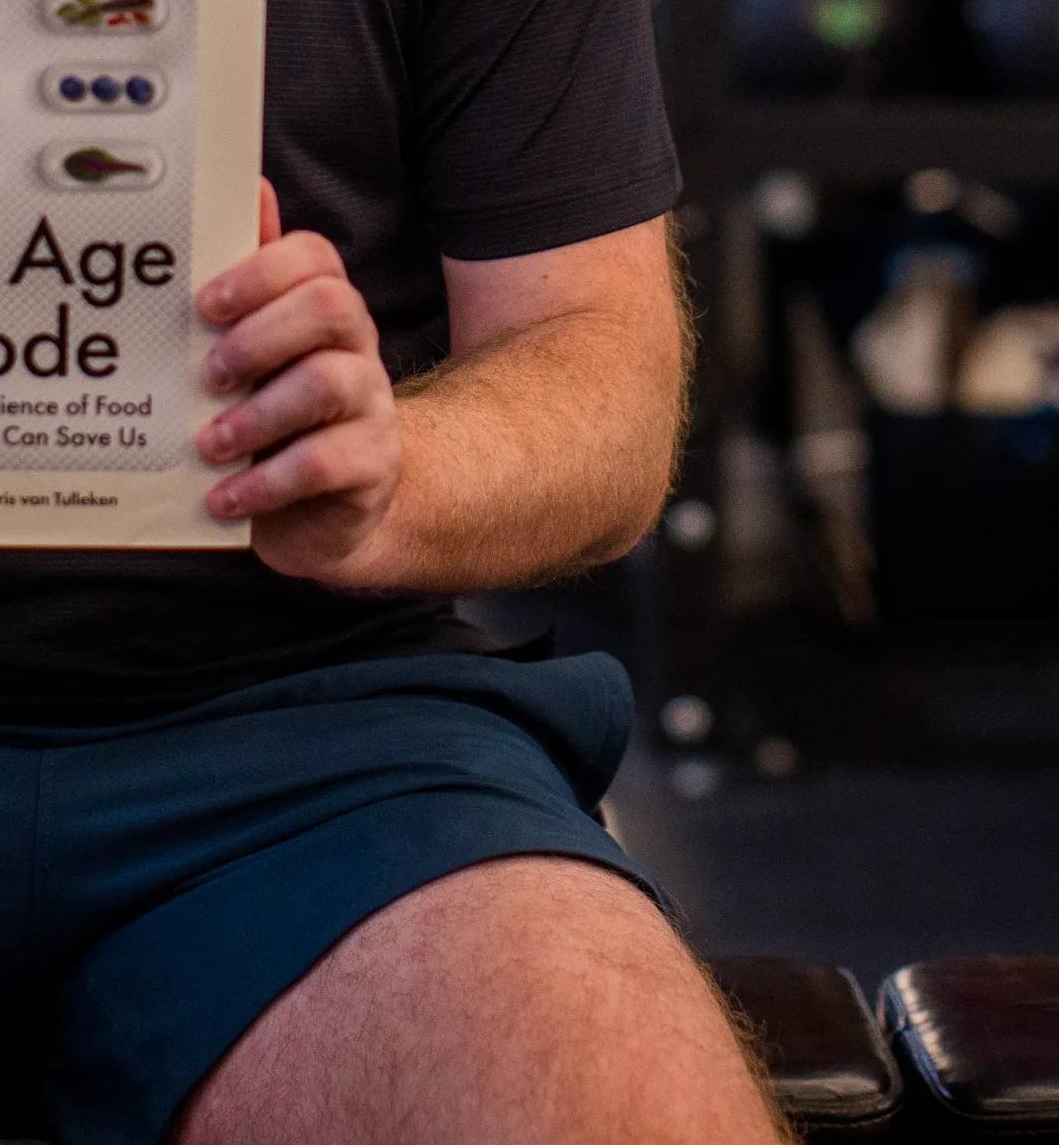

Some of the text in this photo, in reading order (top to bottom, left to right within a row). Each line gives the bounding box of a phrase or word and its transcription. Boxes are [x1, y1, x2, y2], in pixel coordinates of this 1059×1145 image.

[8, 215, 177, 307] Age
[66, 393, 90, 415] of
[95, 394, 153, 416] Food
[3, 425, 49, 446] Can
[56, 425, 111, 447] Save
[118, 426, 148, 448] Us
[20, 493, 50, 506] van
[53, 491, 119, 507] Tulleken
